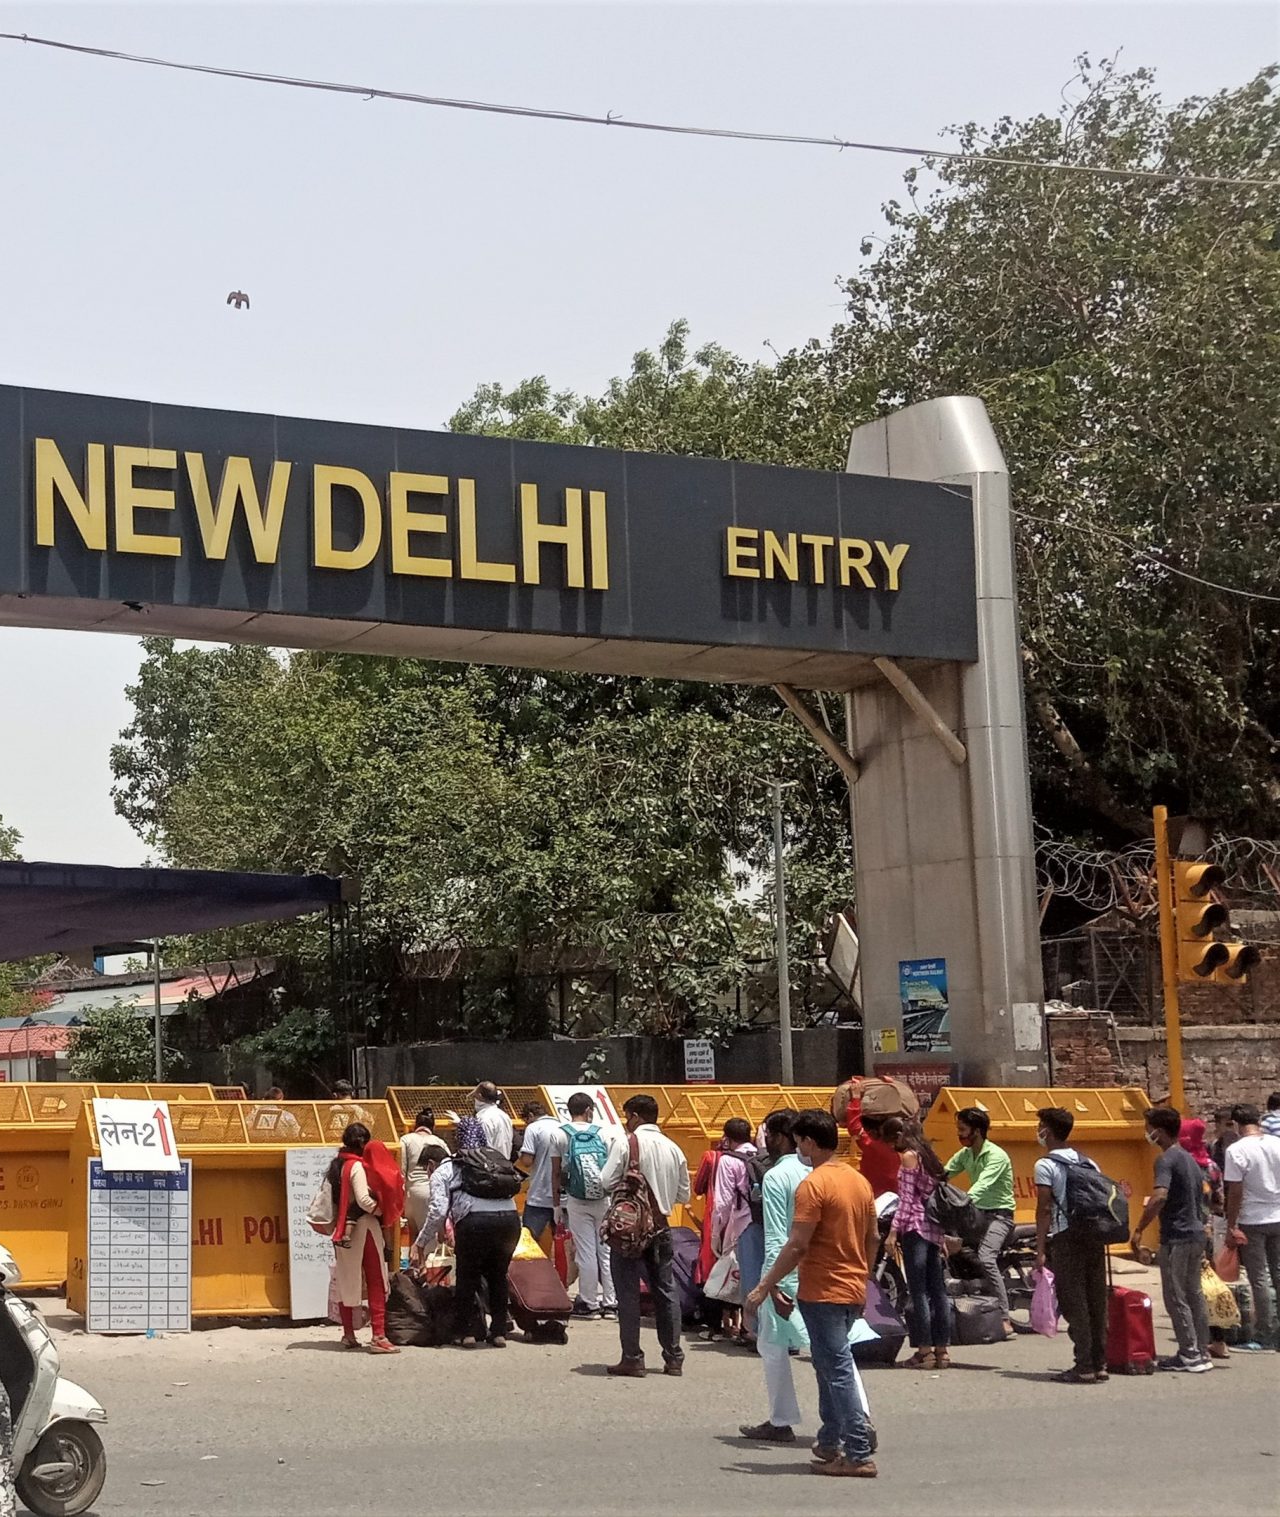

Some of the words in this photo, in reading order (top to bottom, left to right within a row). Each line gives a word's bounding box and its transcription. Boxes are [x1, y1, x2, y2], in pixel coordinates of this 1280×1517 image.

[35, 438, 292, 564] NEW
[314, 464, 609, 590] DELHI
[726, 526, 910, 591] ENTRY
[100, 1114, 157, 1147] लेन-2
